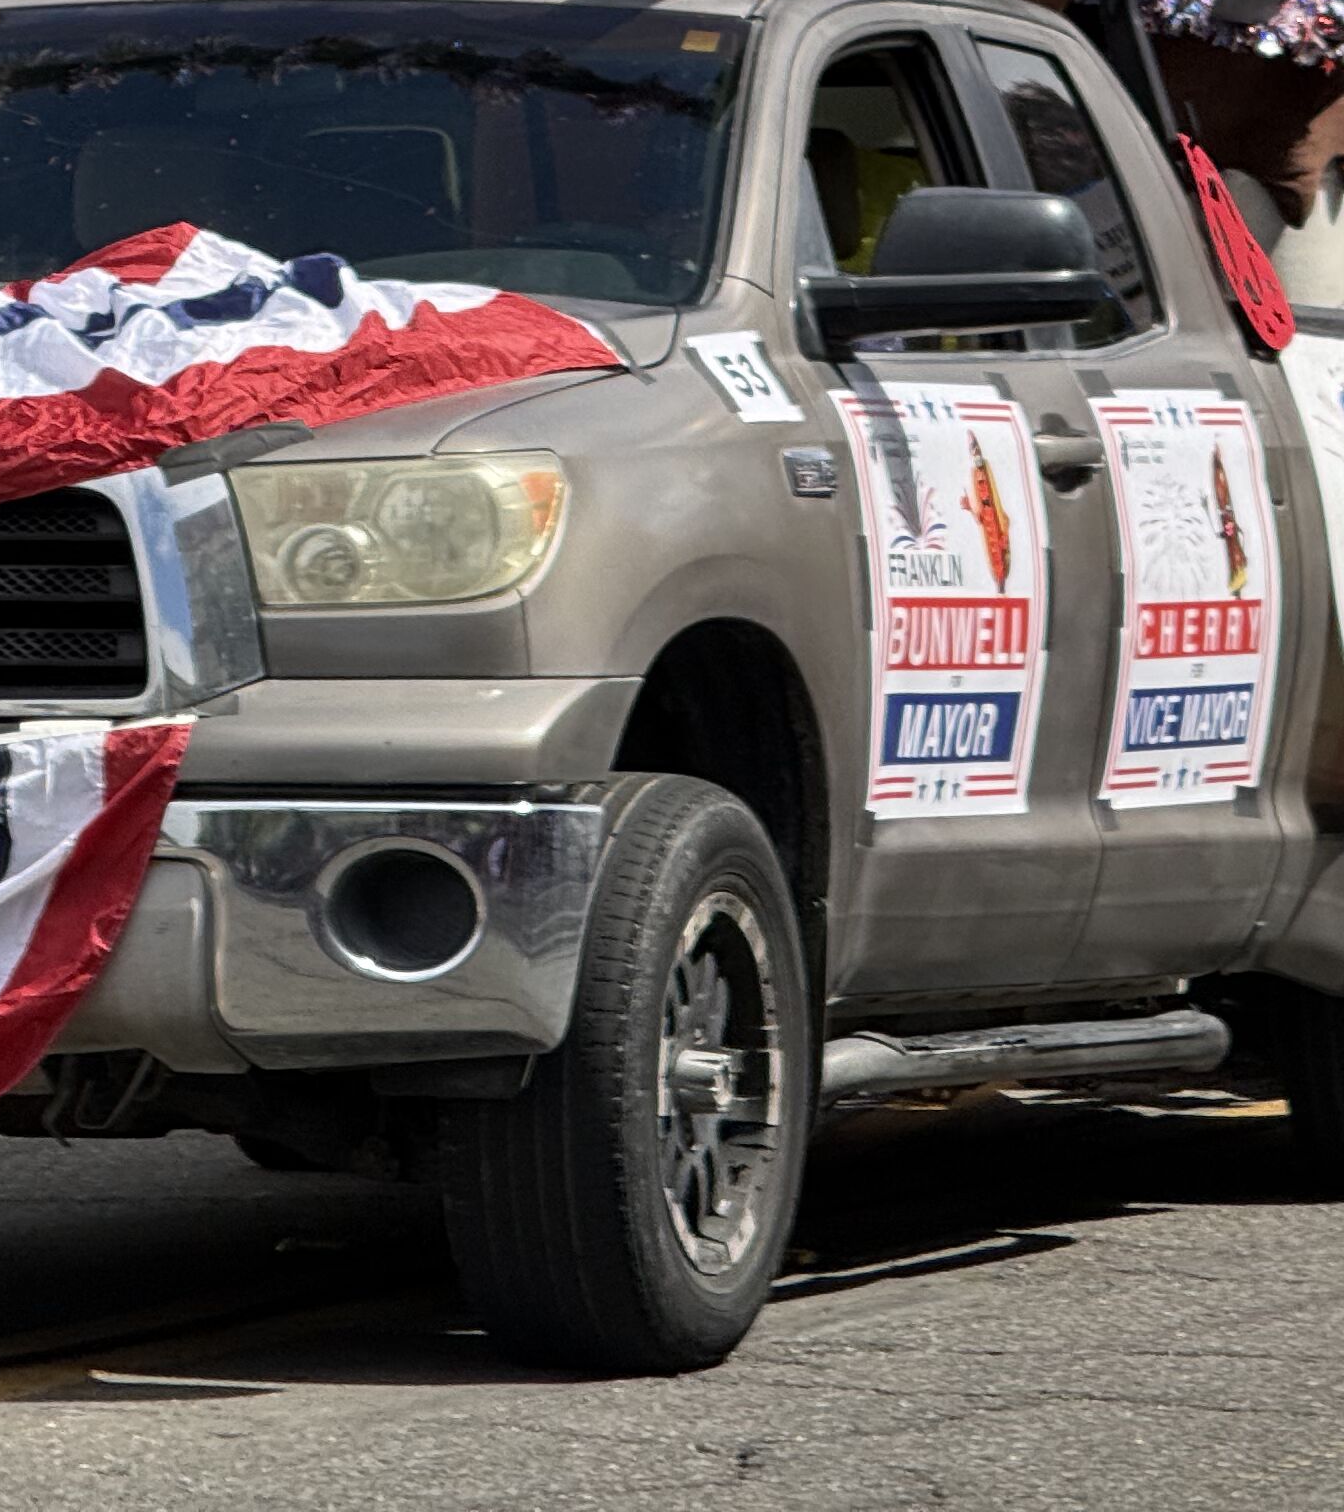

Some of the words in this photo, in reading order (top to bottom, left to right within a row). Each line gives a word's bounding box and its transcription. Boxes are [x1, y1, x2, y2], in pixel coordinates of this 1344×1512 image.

[714, 353, 772, 398] 53
[888, 552, 964, 589] FRANKLIN
[887, 604, 1026, 667] BUNWELL
[1137, 605, 1259, 656] CHERRY
[896, 700, 1000, 759] MAYOR
[1128, 694, 1180, 746] VICE
[1180, 690, 1251, 744] MAYOR
